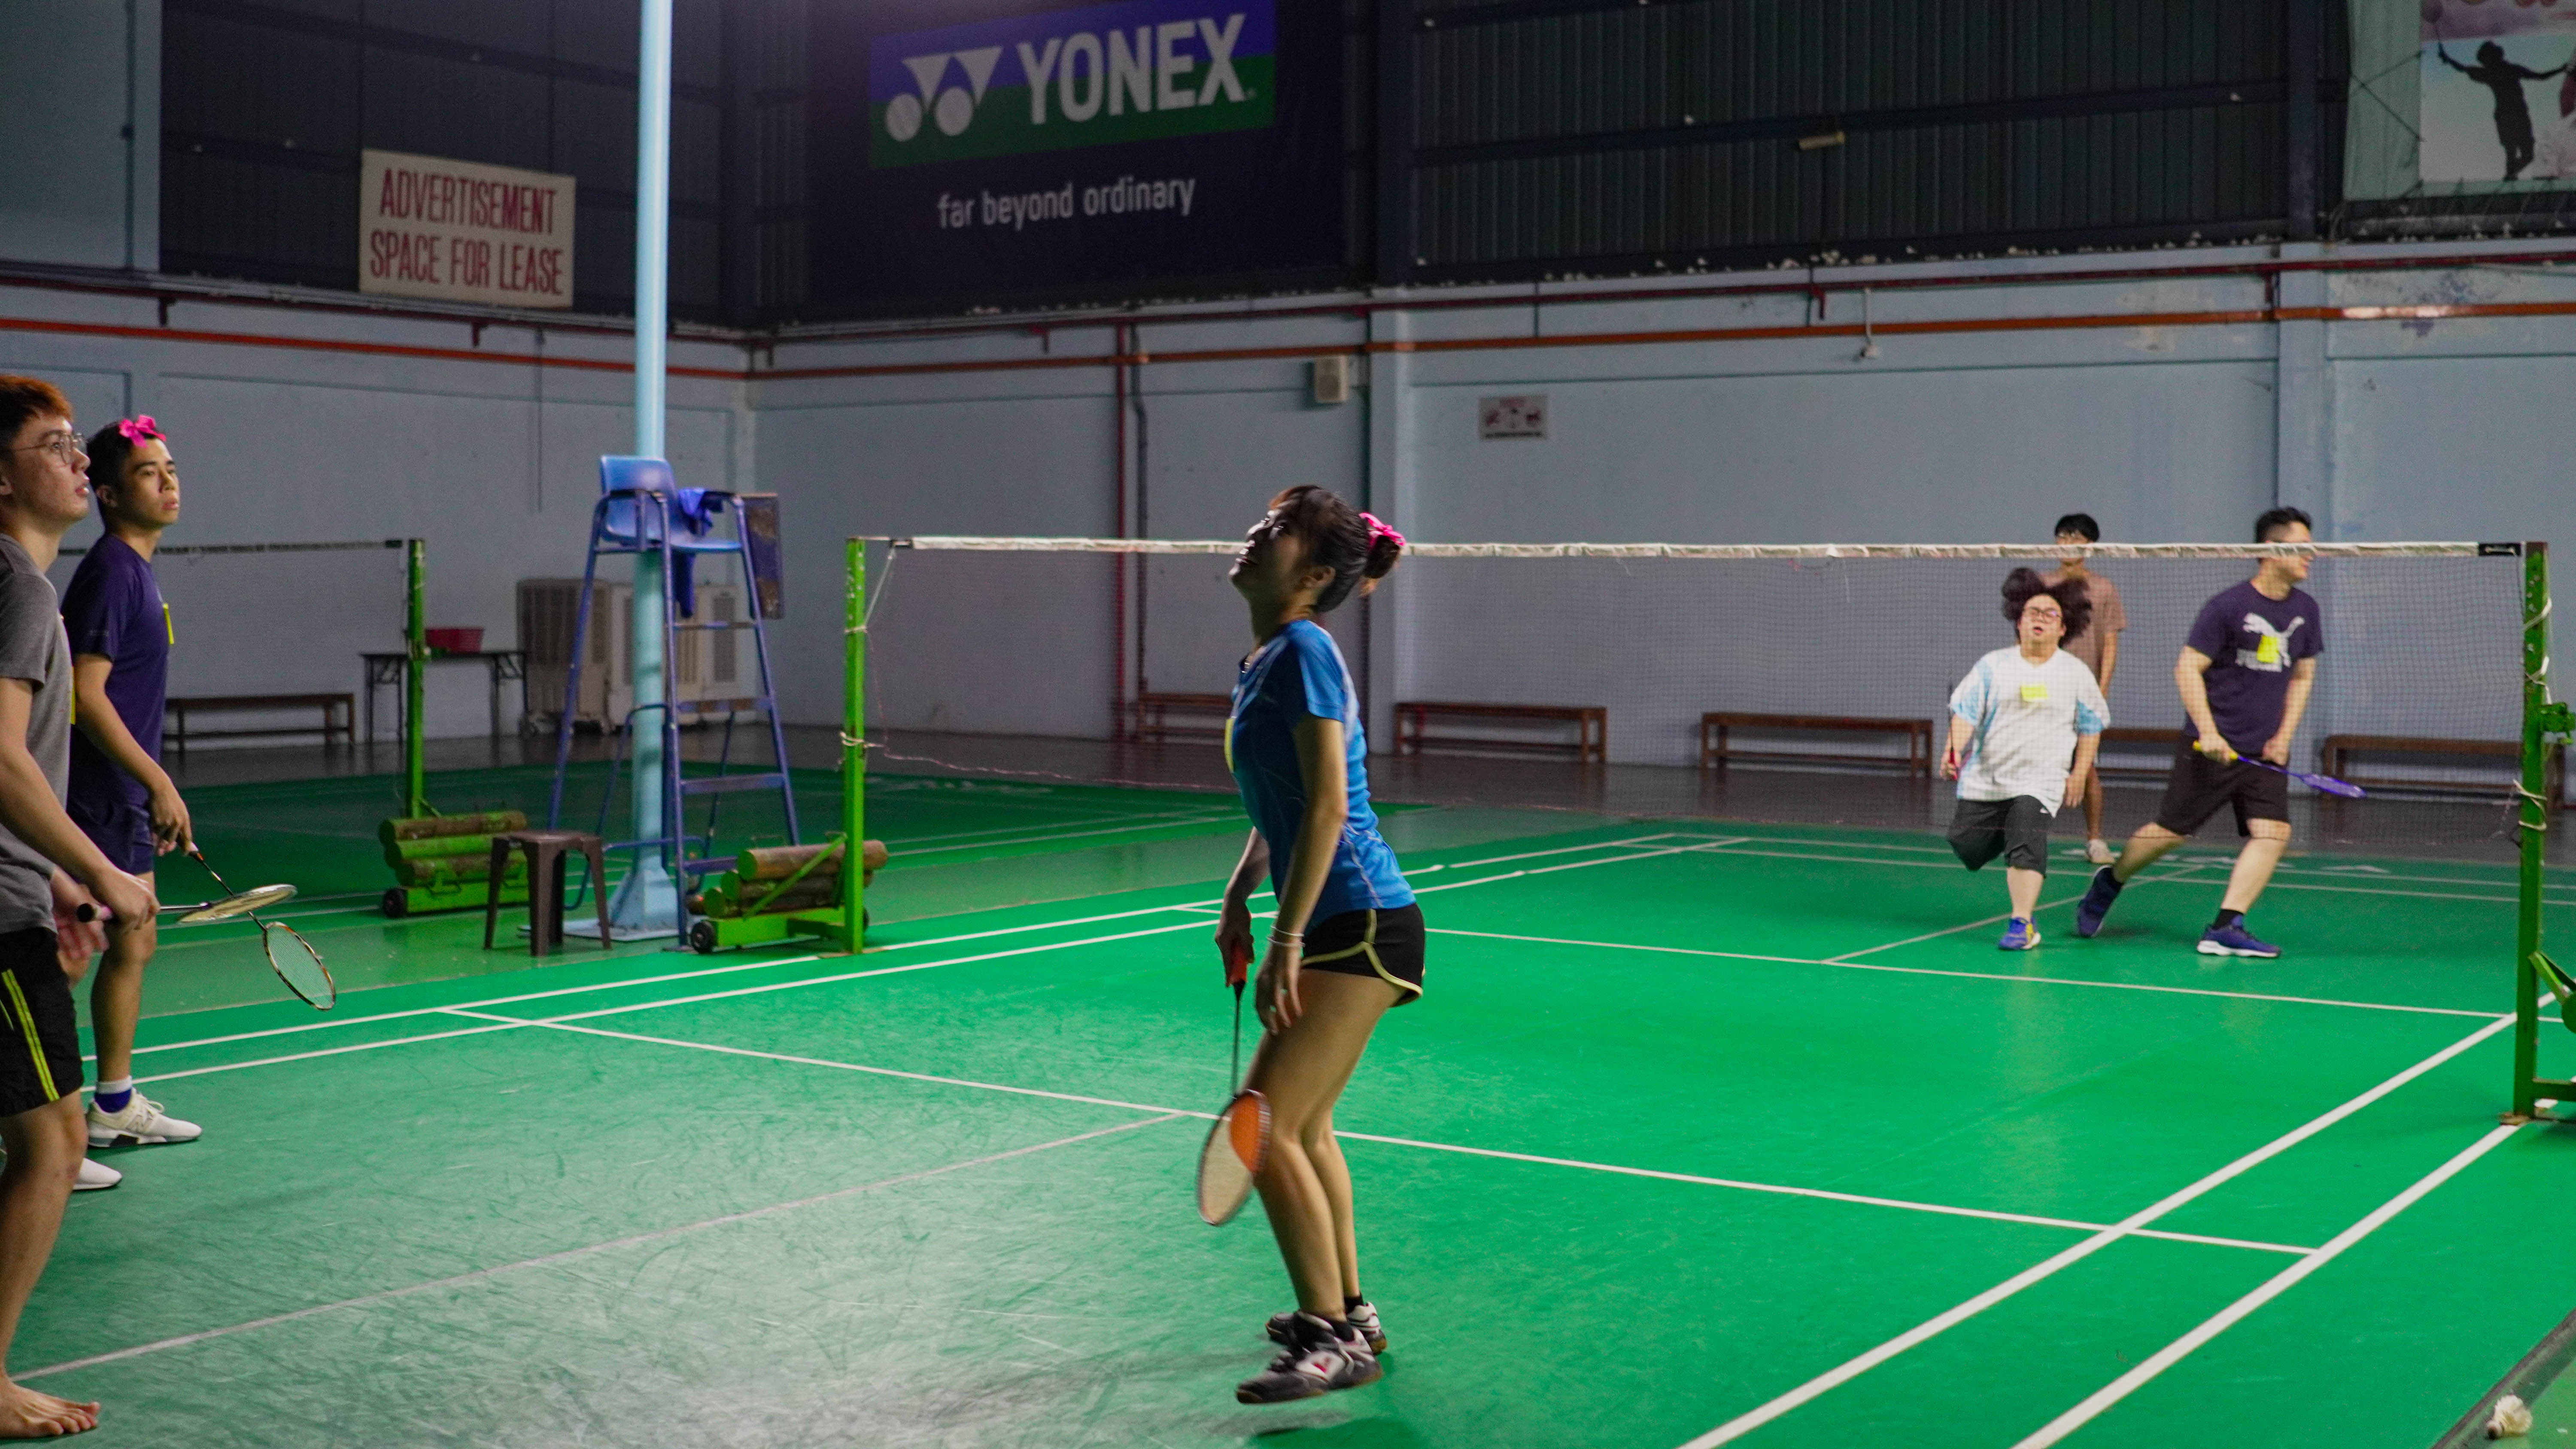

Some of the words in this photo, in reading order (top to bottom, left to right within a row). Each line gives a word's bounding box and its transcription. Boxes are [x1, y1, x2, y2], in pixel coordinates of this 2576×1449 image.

[1016, 13, 1246, 124] YONEX
[380, 167, 556, 235] ADVERTISEMENT
[937, 192, 975, 229] far
[982, 181, 1073, 231] beyond
[1083, 175, 1196, 216] ordinary
[371, 229, 442, 284] SPACE
[450, 237, 490, 288] FOR
[498, 243, 563, 296] LEASE
